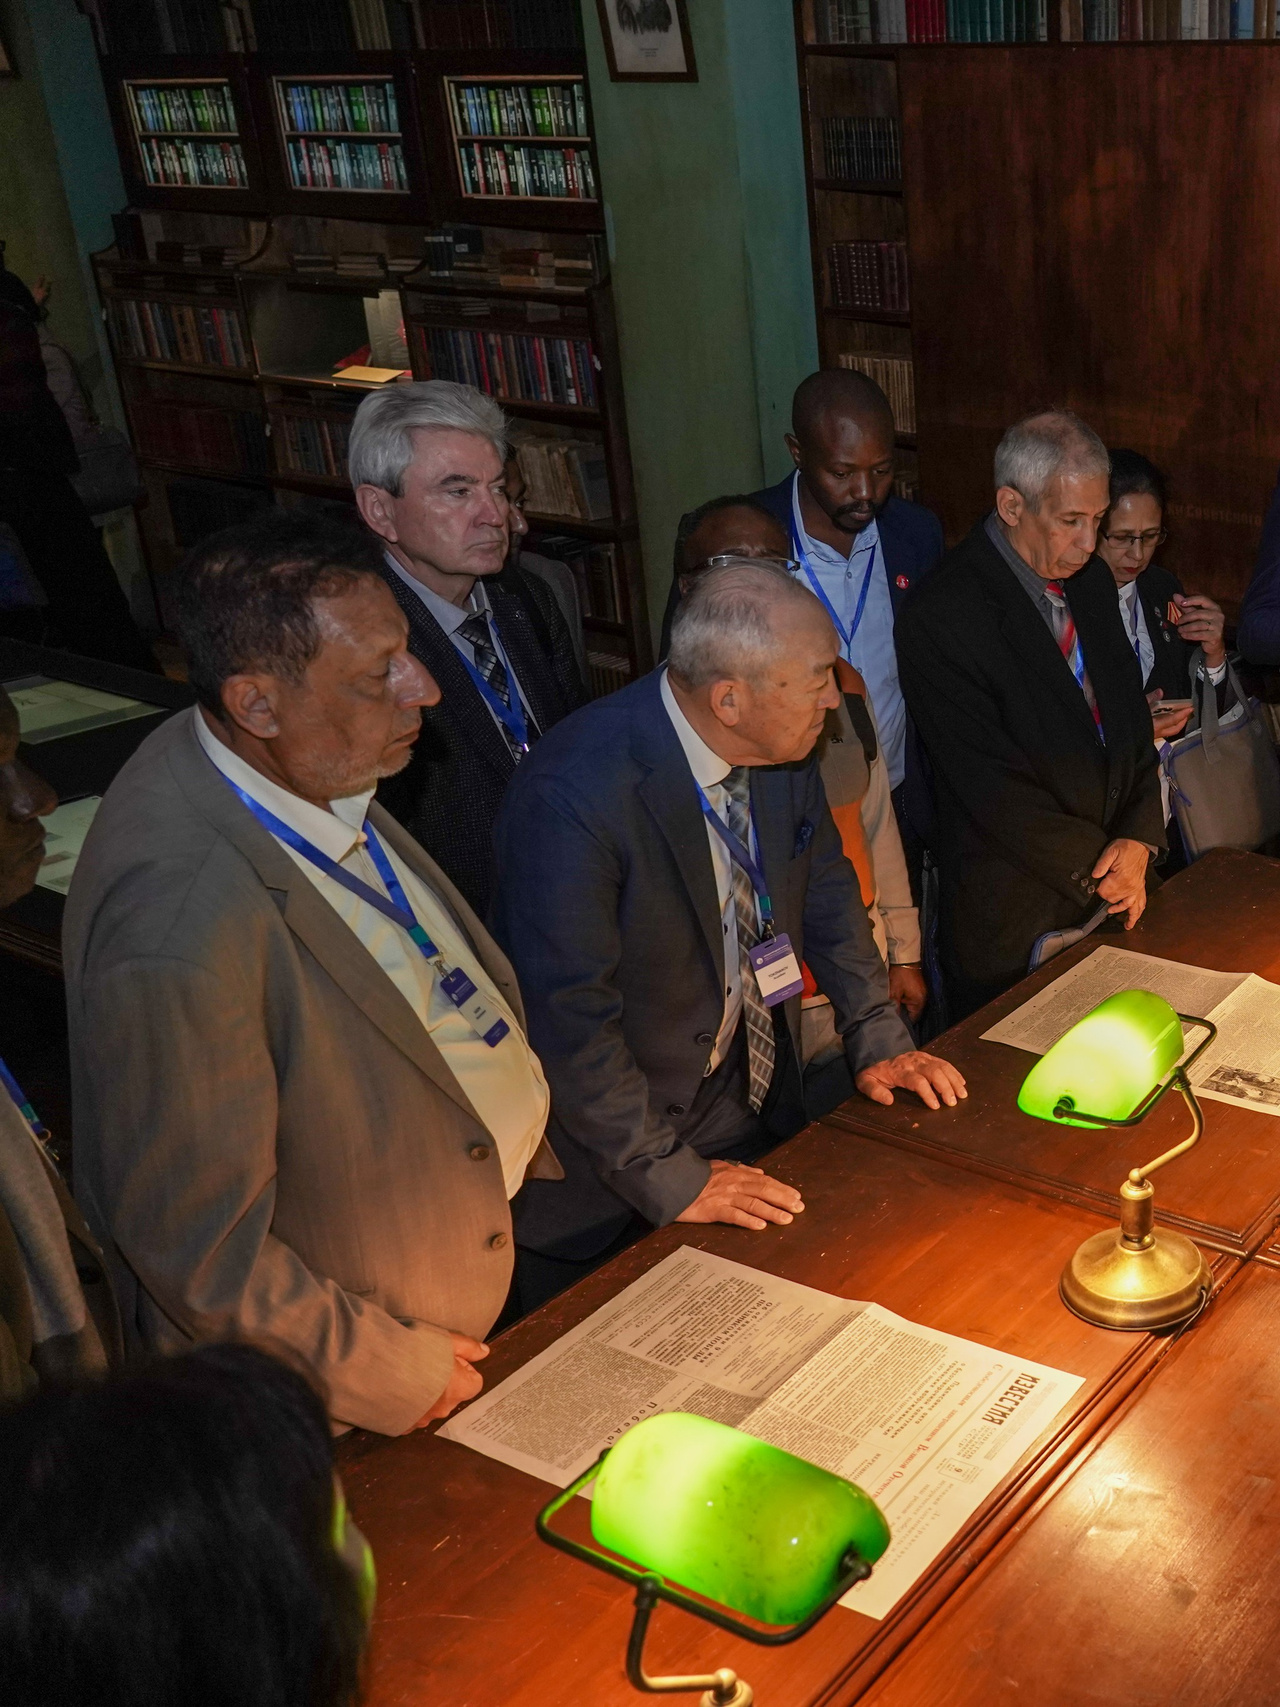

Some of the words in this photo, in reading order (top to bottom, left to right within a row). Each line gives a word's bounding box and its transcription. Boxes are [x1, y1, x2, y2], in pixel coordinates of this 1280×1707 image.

[719, 1298, 767, 1335] ПРАЗДНИКОМ
[689, 1335, 723, 1360] ПОБЕДЫ
[979, 1372, 1042, 1426] ИЗВЕСТИЯ
[897, 1443, 929, 1470] Великой
[869, 1469, 904, 1500] Отечеств
